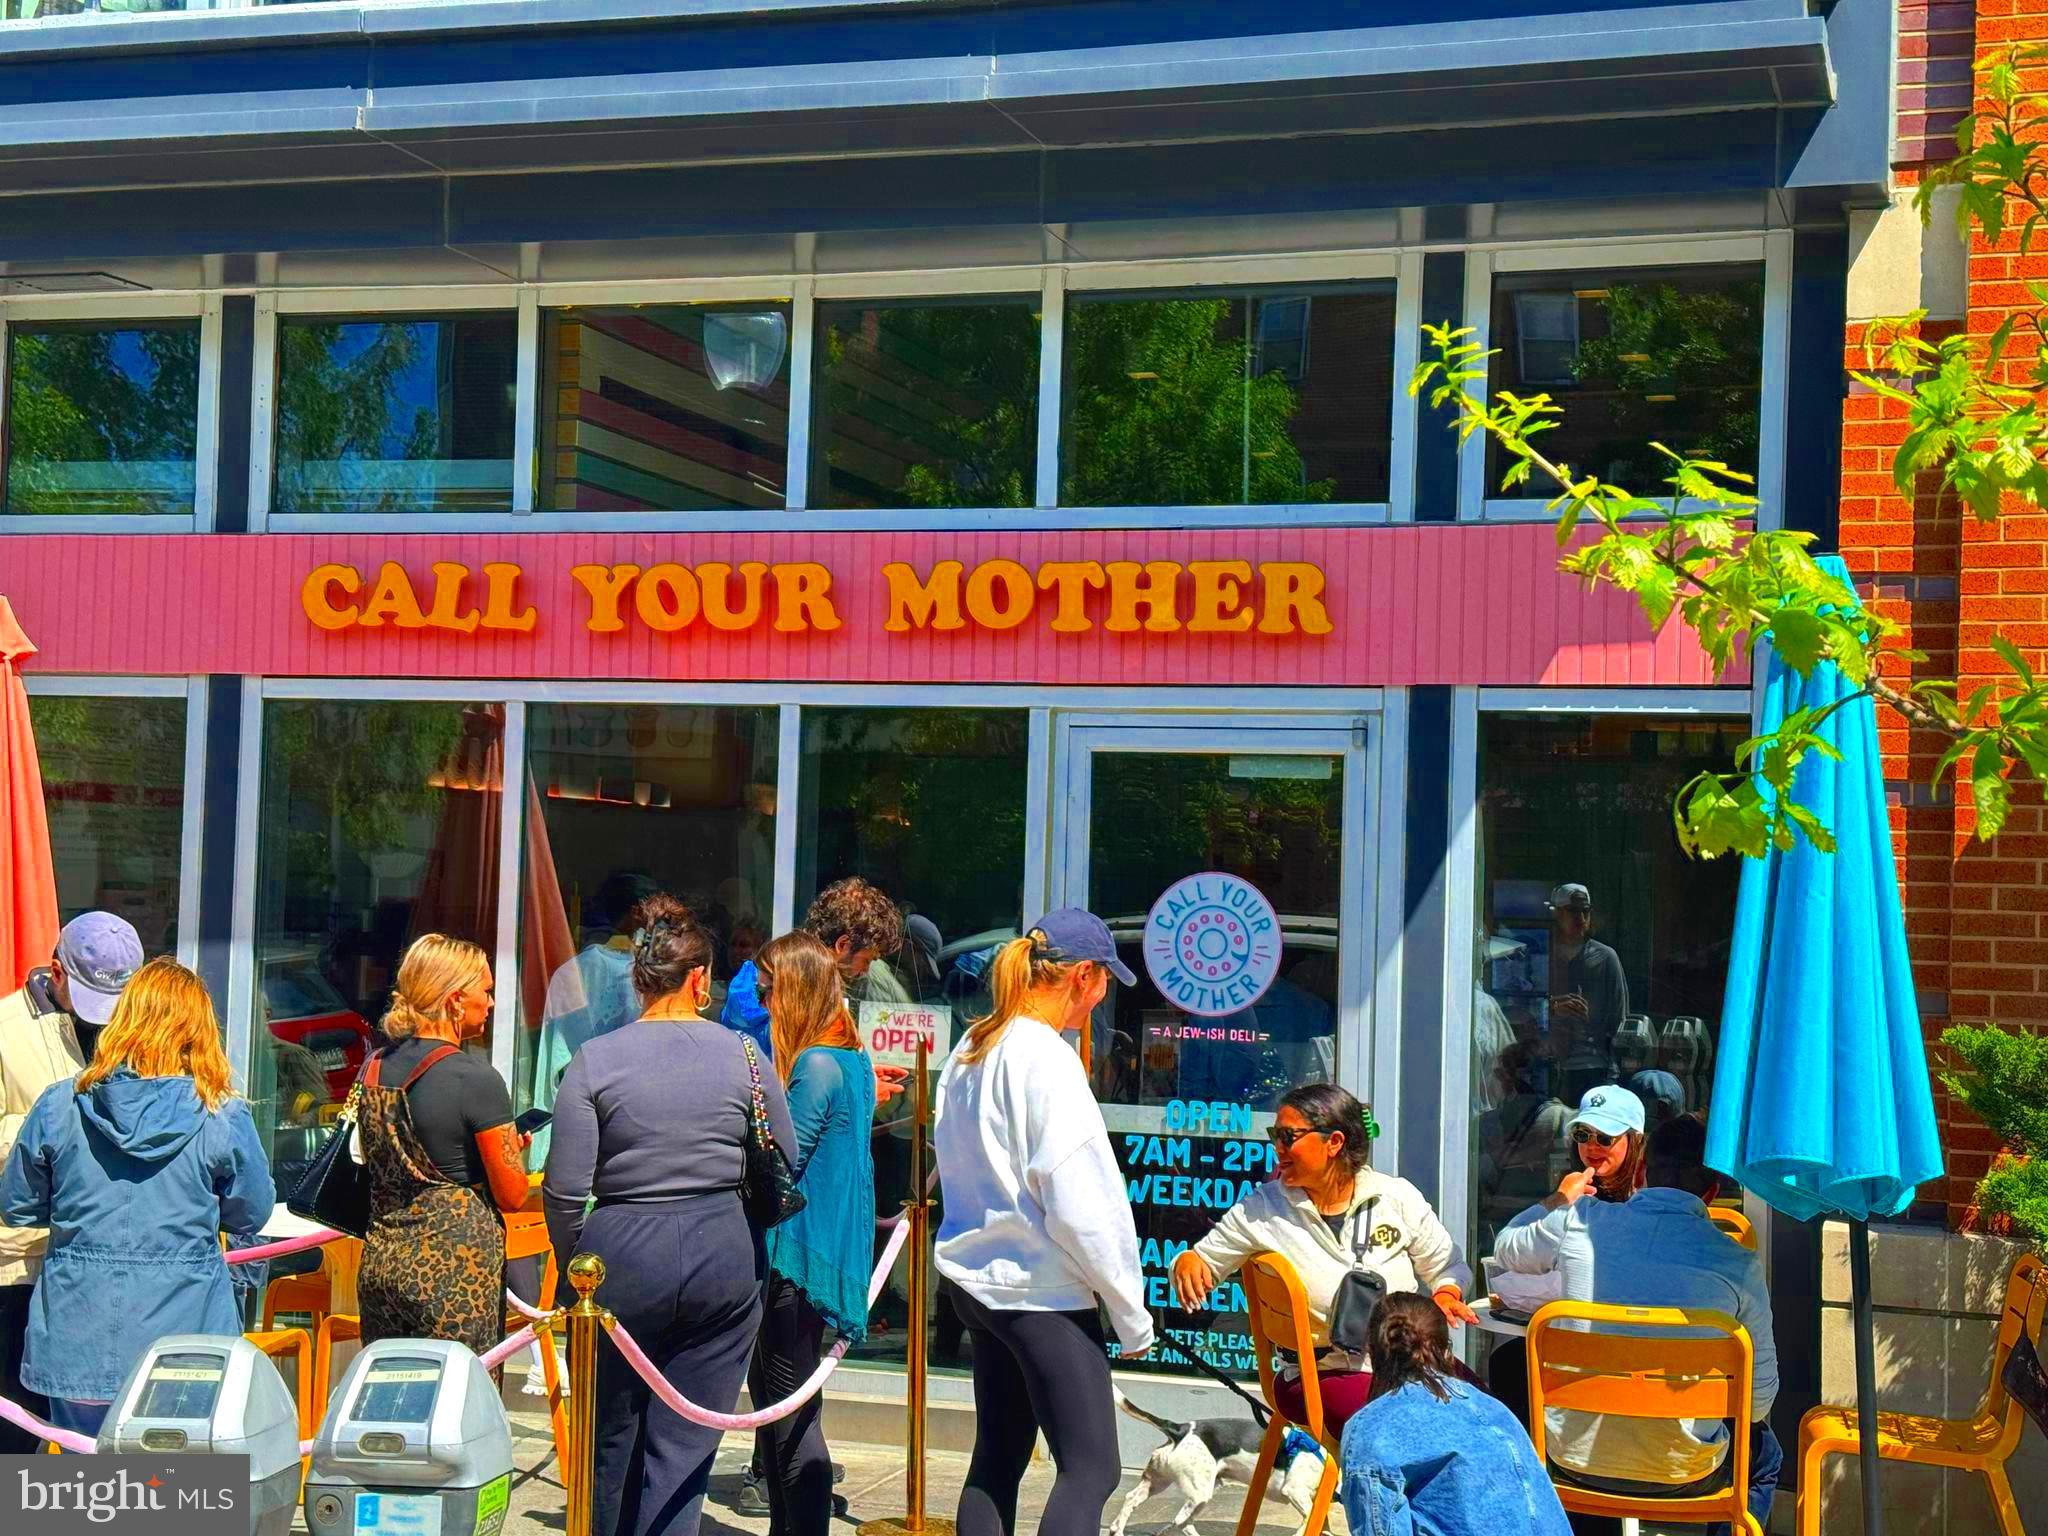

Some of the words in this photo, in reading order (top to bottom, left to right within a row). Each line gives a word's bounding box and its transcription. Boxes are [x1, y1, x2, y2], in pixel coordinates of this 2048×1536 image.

[302, 561, 538, 633] CALL
[571, 561, 843, 633] YOUR
[881, 558, 1334, 635] MOTHER
[1155, 881, 1209, 930] CALL
[1221, 881, 1272, 934] YOUR
[1160, 967, 1260, 1010] MOTHER
[893, 1013, 935, 1028] WE'RE
[1163, 1026, 1172, 1037] A
[1175, 1026, 1226, 1040] JEW-ISH
[1230, 1029, 1256, 1042] DELI
[872, 1028, 935, 1054] OPEN
[1166, 1099, 1251, 1133] OPEN
[1125, 1135, 1191, 1168] 7AM
[1121, 1173, 1262, 1209] WEEKDA
[1137, 1237, 1189, 1269] AM
[1208, 1332, 1255, 1351] PLEAS
